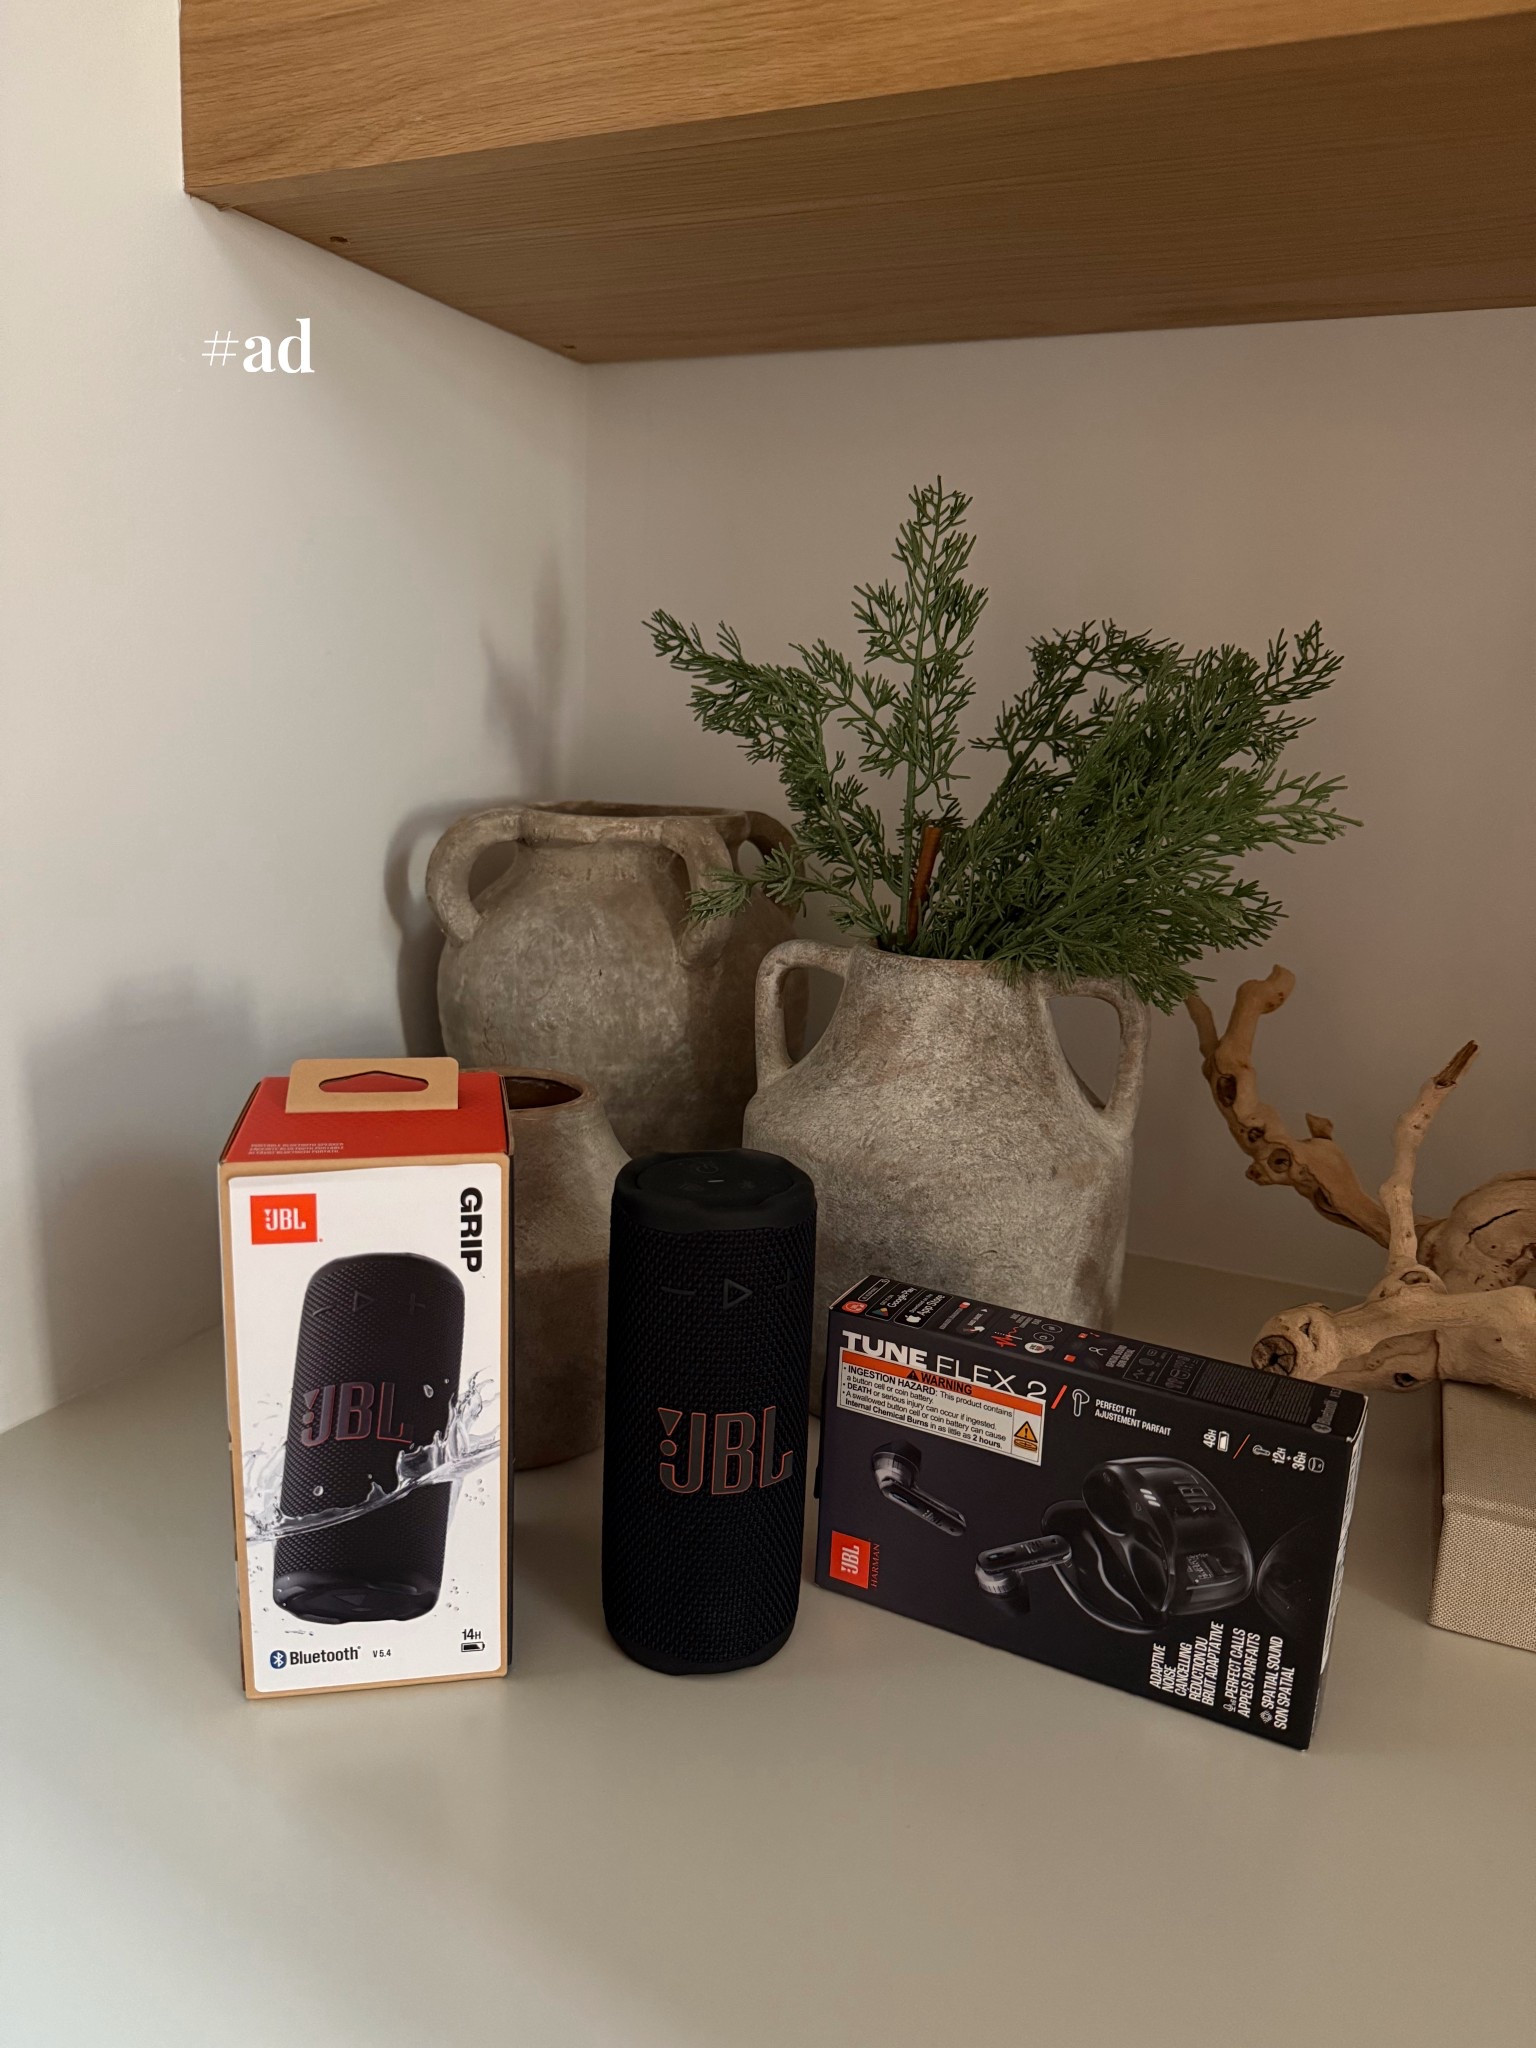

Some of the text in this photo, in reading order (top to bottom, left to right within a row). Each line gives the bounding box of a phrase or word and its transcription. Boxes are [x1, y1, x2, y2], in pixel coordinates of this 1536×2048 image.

[264, 1208, 307, 1231] JBL
[460, 1187, 483, 1273] GRIP
[842, 1330, 1047, 1398] TUNE FLEX 2
[921, 1372, 972, 1395] WARNING
[847, 1382, 872, 1395] DEATH
[882, 1392, 906, 1404] serious
[906, 1397, 924, 1410] injury
[926, 1404, 938, 1414] can
[940, 1409, 959, 1419] occur
[966, 1415, 997, 1430] ingested.
[848, 1365, 1013, 1417] INGESTION HAZARD: This product contains
[852, 1376, 872, 1386] button
[874, 1382, 885, 1390] cell
[895, 1388, 908, 1396] coin
[910, 1391, 934, 1404] battery.
[1095, 1398, 1137, 1417] PERFECT FIT
[301, 1381, 414, 1448] JBL
[845, 1398, 872, 1411] Internal
[872, 1406, 906, 1421] Chemical
[906, 1415, 928, 1427] Burns
[930, 1422, 937, 1430] in
[948, 1427, 961, 1436] little
[962, 1432, 972, 1440] as
[979, 1436, 1002, 1449] hours.
[846, 1390, 852, 1398] A
[852, 1394, 885, 1406] swallowed
[887, 1402, 908, 1412] button
[909, 1408, 920, 1416] cell
[930, 1414, 944, 1424] coin
[946, 1417, 970, 1432] battery
[970, 1426, 984, 1434] can
[985, 1430, 1006, 1441] cause
[1094, 1409, 1172, 1436] AJUSTEMENT PARFAIT
[657, 1405, 793, 1495] JBL
[1202, 1428, 1217, 1448] 48H
[1272, 1446, 1286, 1464] 12H
[1292, 1451, 1307, 1471] 36H
[840, 1545, 860, 1574] JBL
[870, 1543, 880, 1588] HARMAN
[461, 1628, 482, 1641] 14H
[1195, 1636, 1208, 1651] DU
[1230, 1628, 1246, 1658] CALLS
[290, 1647, 359, 1666] Bluetooth
[1150, 1643, 1166, 1690] ADAPTIVE
[1174, 1642, 1192, 1696] CANCELLING
[1202, 1621, 1224, 1706] BRUIT ADAPTATIVE
[1238, 1632, 1260, 1718] APPELS PARFAITS
[1262, 1636, 1284, 1710] SPATIAL SOUND
[1162, 1664, 1176, 1694] NOISE
[1225, 1658, 1242, 1700] PERFECT
[1274, 1666, 1295, 1730] SON SPATIAL
